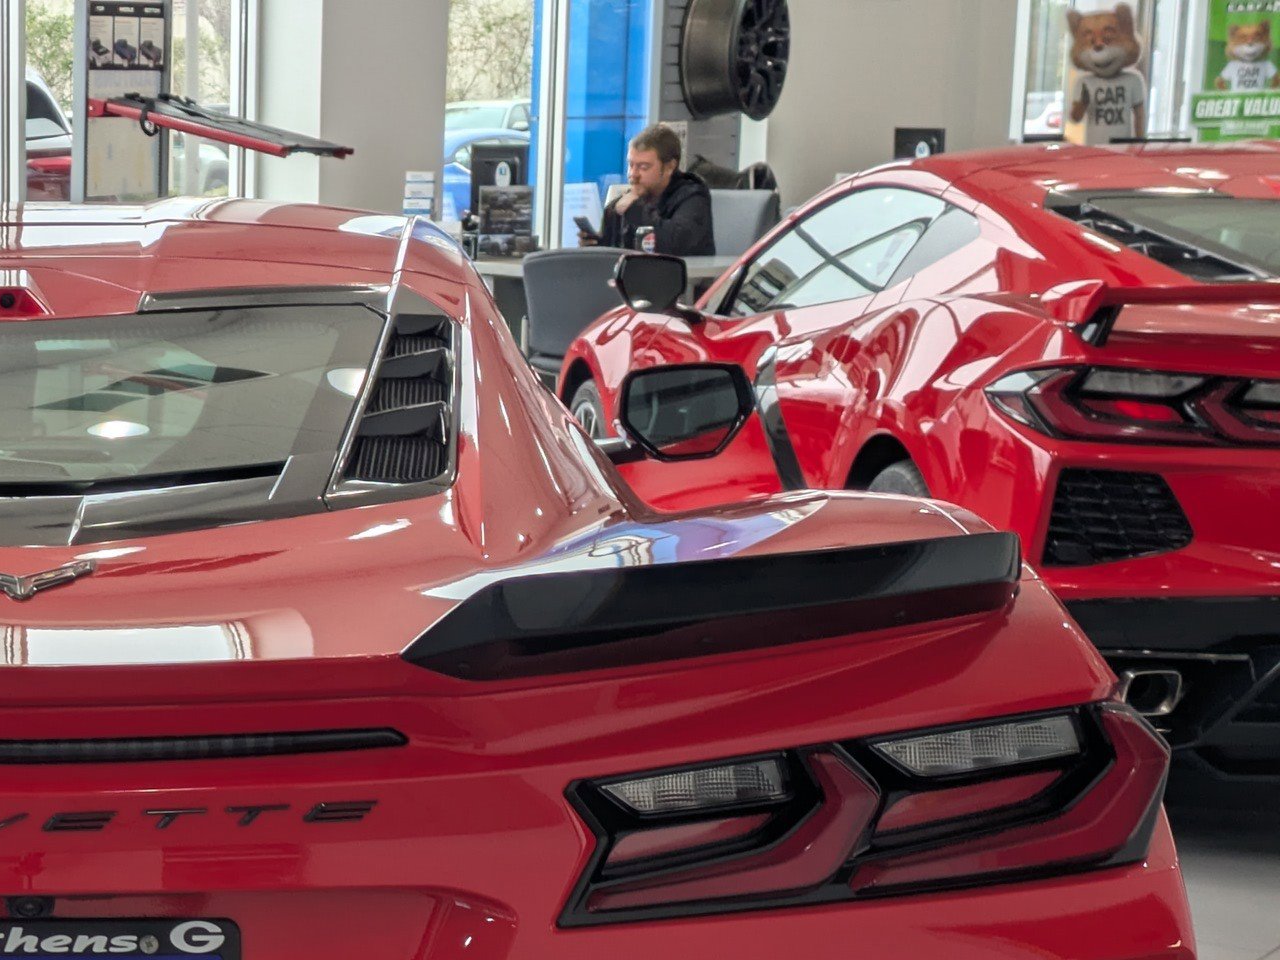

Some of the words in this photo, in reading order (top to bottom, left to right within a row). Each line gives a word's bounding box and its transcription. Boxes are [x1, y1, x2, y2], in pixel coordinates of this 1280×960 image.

[1094, 86, 1126, 106] CAR
[1095, 107, 1125, 126] FOX
[1195, 98, 1240, 118] GREAT
[169, 920, 226, 954] G
